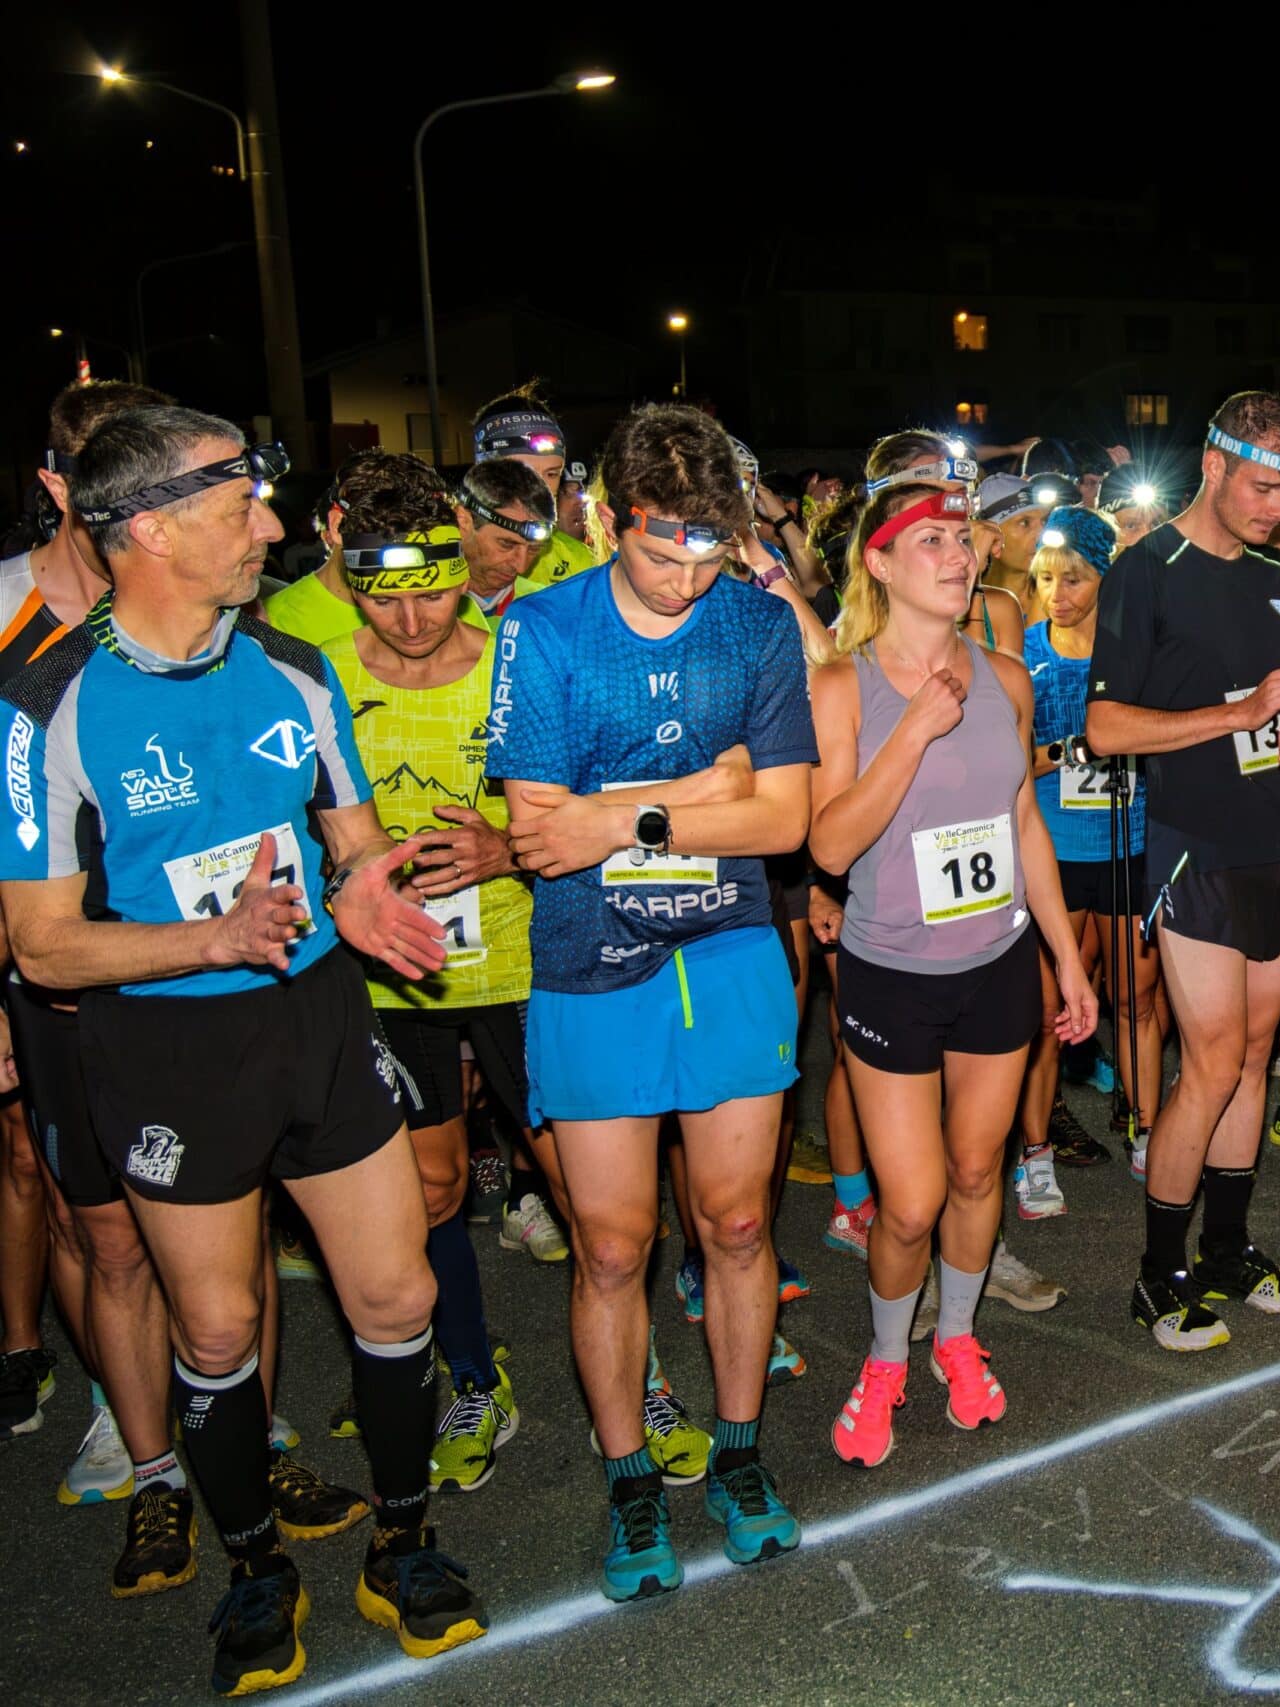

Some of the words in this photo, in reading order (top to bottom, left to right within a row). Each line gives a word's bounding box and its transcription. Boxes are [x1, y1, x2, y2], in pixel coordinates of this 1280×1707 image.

[488, 618, 520, 746] KARPOS
[7, 711, 35, 819] CRAZY
[120, 768, 146, 781] ASD
[121, 775, 173, 794] VAL
[126, 781, 198, 811] SOLE
[174, 798, 200, 808] TEAM
[941, 851, 997, 899] 18
